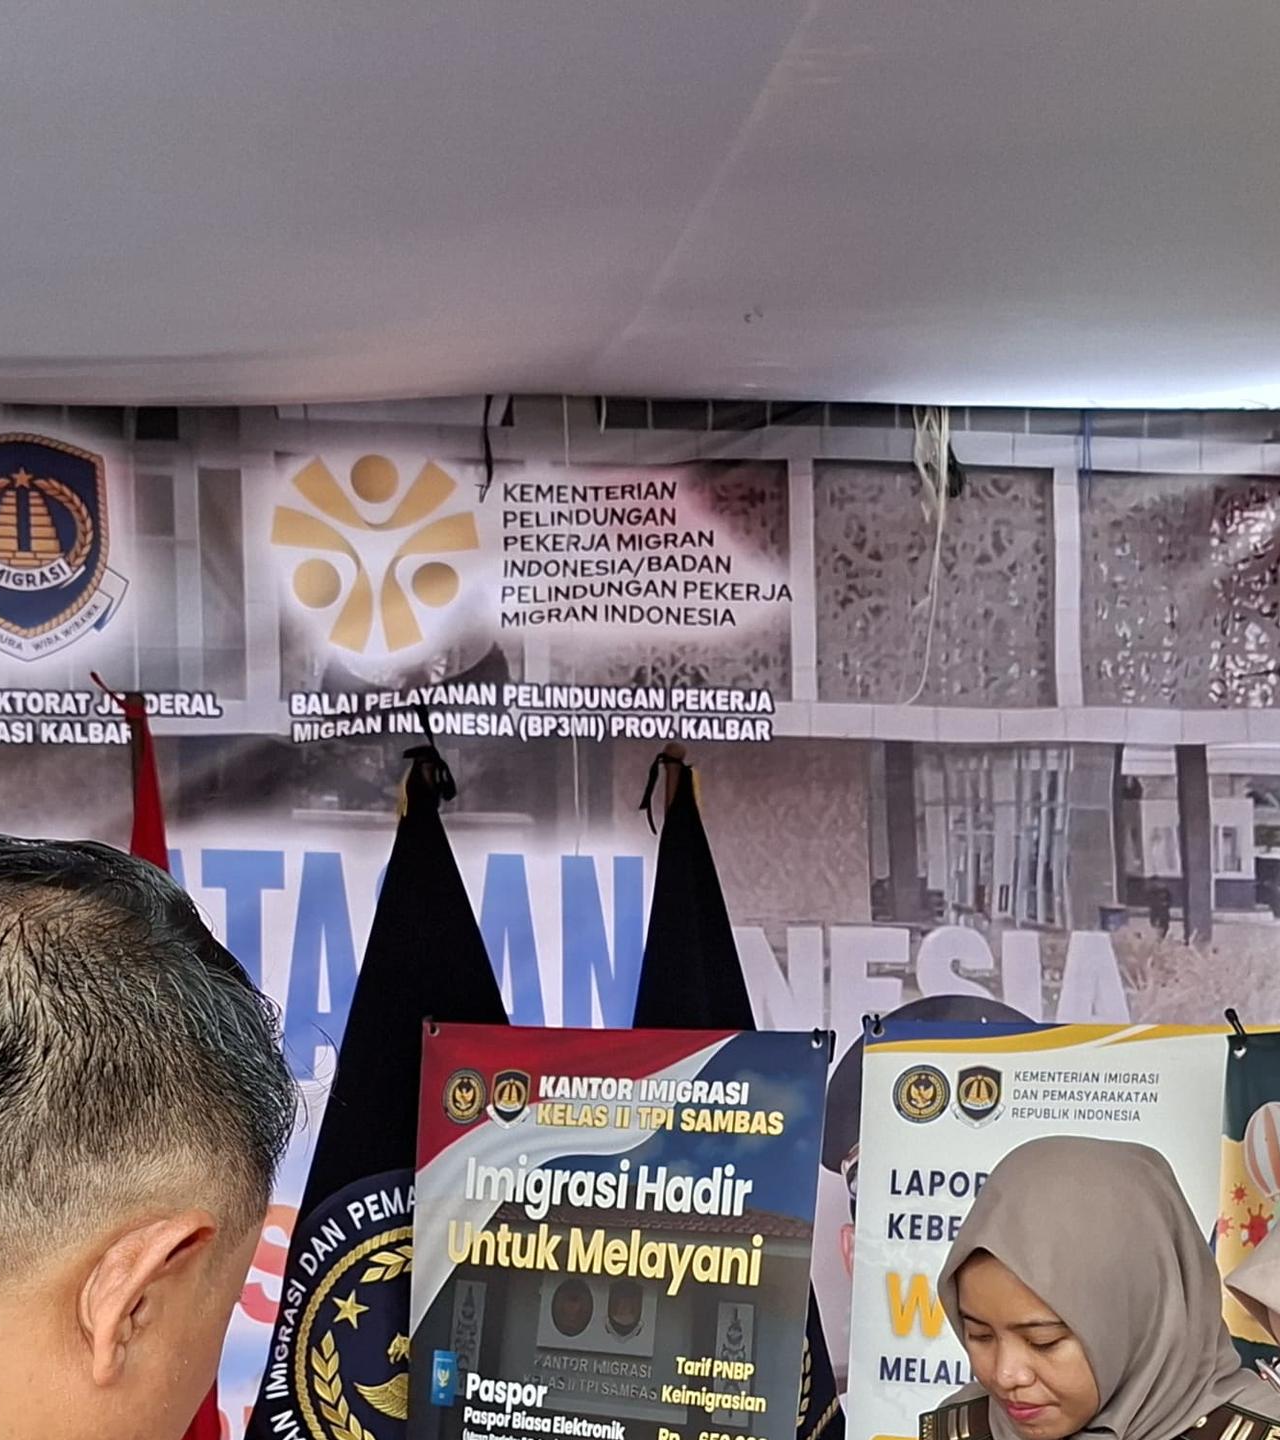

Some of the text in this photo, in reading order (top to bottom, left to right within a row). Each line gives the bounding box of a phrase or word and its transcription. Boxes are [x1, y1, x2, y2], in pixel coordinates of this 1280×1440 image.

[503, 482, 677, 503] KEMENTERIAN
[503, 508, 677, 529] PELINDUNGAN
[503, 531, 714, 553] PEKERJA MIGRAN
[502, 581, 793, 604] PELINDUNGAN PEKERJA
[501, 605, 736, 629] MIGRAN INDONESIA
[96, 692, 220, 716] JEDERAL
[291, 684, 773, 716] BALAI PELAYANAN PELINDUNGAN PEKERJA
[519, 713, 773, 743] (BP3MI) PROV. KALBAR
[1013, 1071, 1100, 1085] KEMENTERIAN
[538, 1075, 749, 1106] KANTOR IMIGRASI
[536, 1103, 784, 1136] KELAS II TPI SAMBAS
[1011, 1107, 1070, 1121] REPUBLIK
[465, 1155, 629, 1220] Imigrasi
[636, 1163, 753, 1217] Hadir
[447, 1220, 764, 1296] Untuk Melayani
[676, 1357, 712, 1377] Tarif
[712, 1358, 755, 1381] PNBP
[661, 1384, 767, 1413] Keimigrasian
[463, 1407, 511, 1431] Paspor
[512, 1412, 551, 1433] Biasa
[553, 1416, 625, 1440] Elektronik
